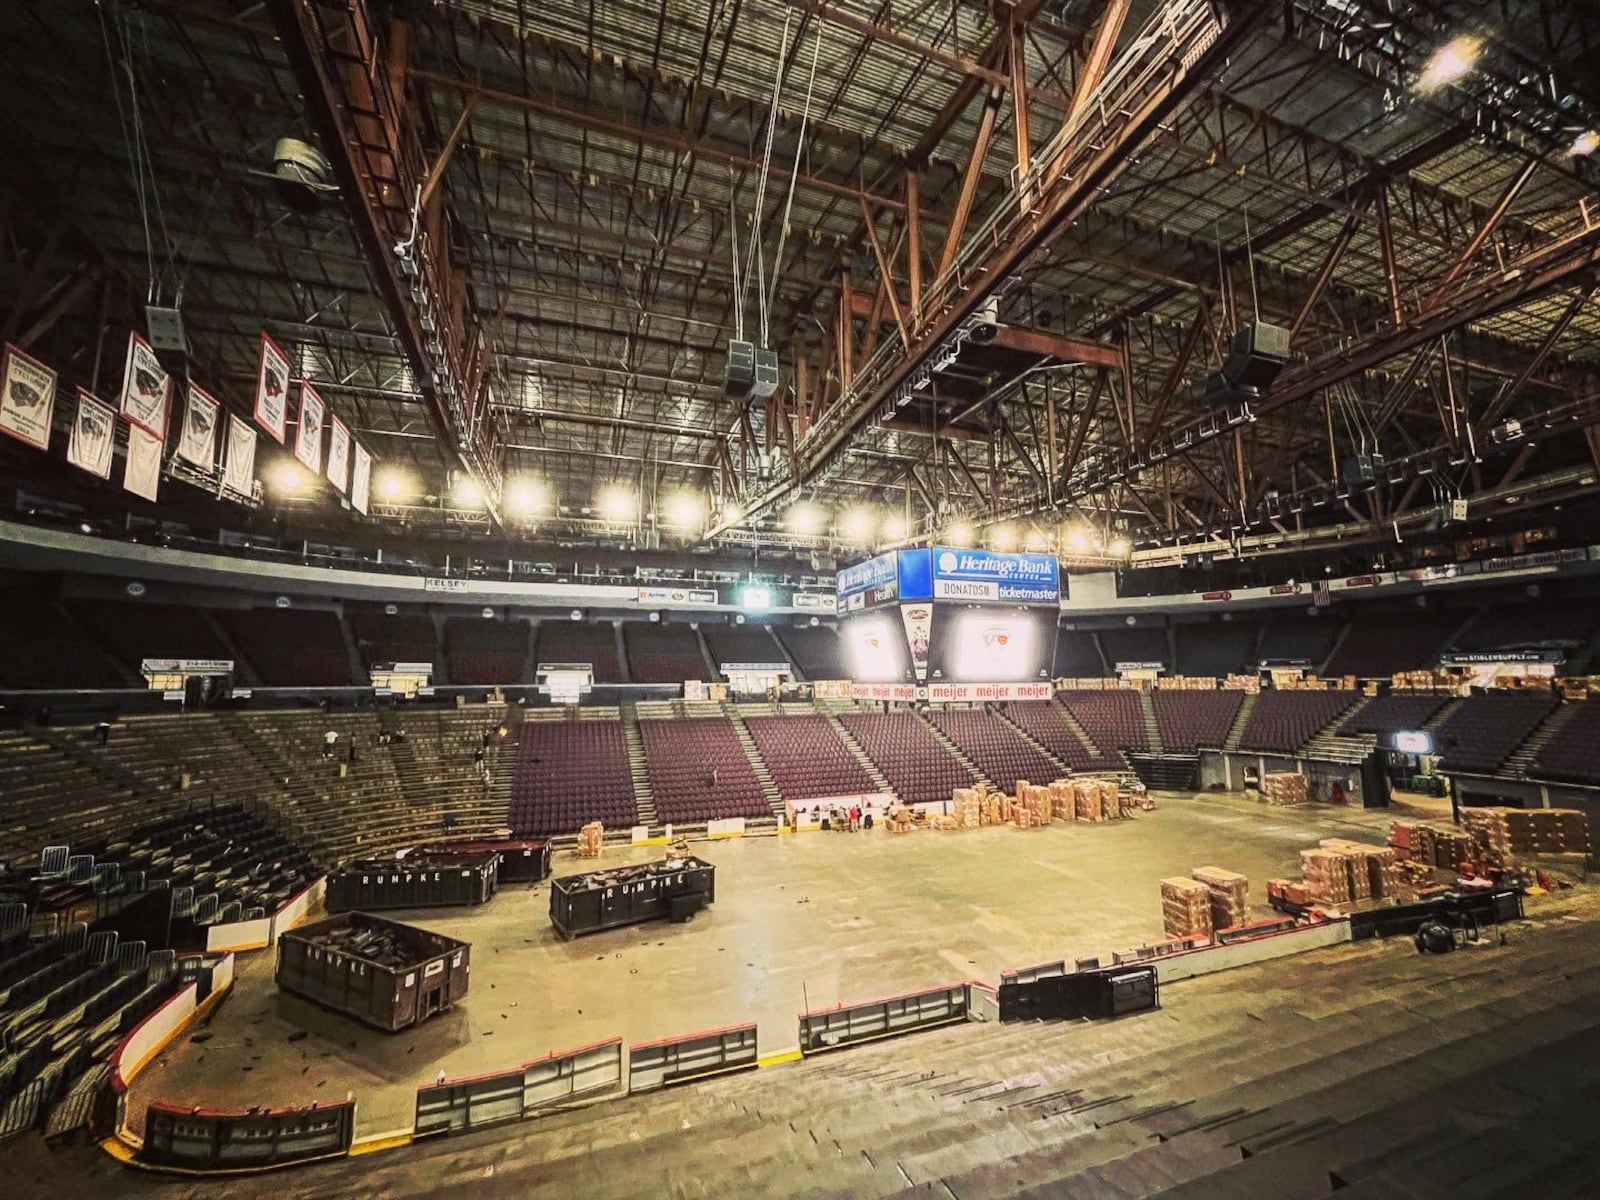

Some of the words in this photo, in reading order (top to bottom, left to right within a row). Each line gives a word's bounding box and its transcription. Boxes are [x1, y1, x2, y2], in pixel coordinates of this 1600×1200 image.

[960, 555, 1017, 576] Heritage
[1018, 559, 1052, 574] Bank
[944, 582, 984, 595] DONATOS
[999, 586, 1058, 600] ticketmaster
[932, 683, 968, 700] meijer
[976, 683, 1009, 699] meijer
[1018, 682, 1049, 698] meijer
[362, 872, 440, 885] RUMPKE
[606, 875, 684, 899] RUMPKE
